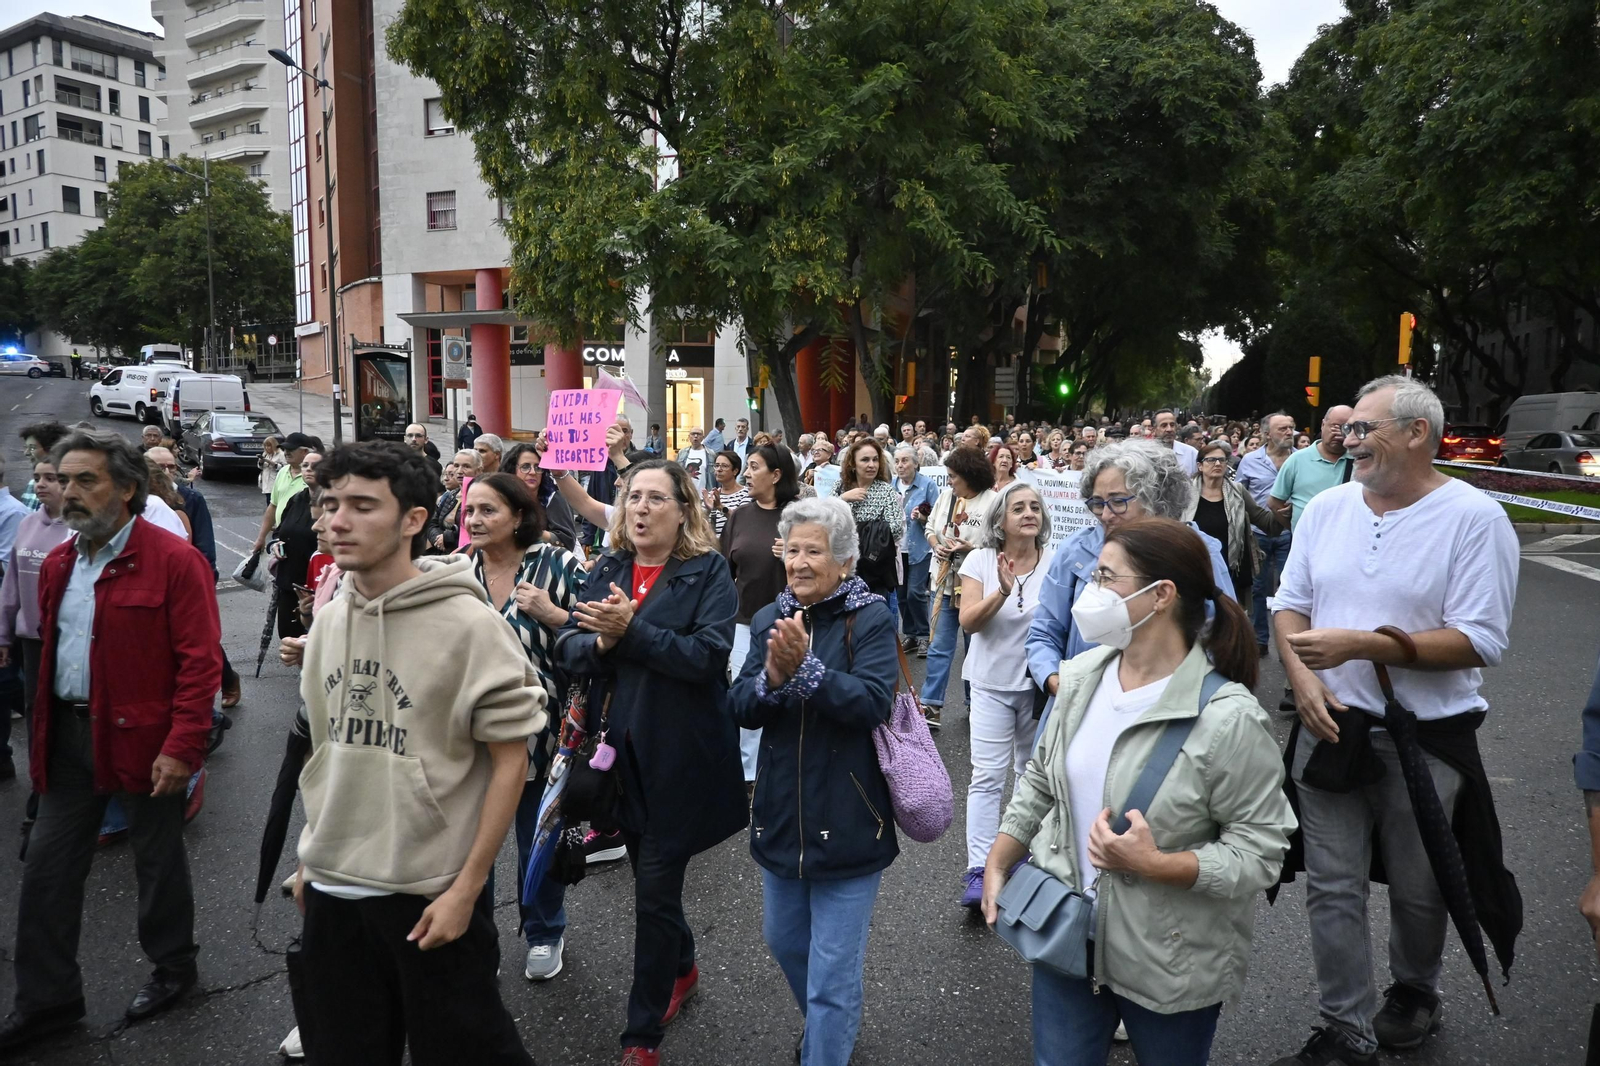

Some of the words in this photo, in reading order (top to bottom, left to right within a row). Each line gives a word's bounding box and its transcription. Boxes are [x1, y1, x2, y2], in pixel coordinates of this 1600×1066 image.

[563, 392, 588, 407] VIDA
[551, 412, 574, 426] VALE
[547, 430, 563, 443] QUE
[568, 428, 589, 443] TUS
[555, 447, 605, 464] RECORTES
[1044, 479, 1080, 489] MOVIMIEN
[1053, 490, 1069, 499] JUNTA
[1070, 491, 1077, 499] DE
[1062, 503, 1074, 513] MÁS
[1061, 516, 1084, 525] SERVICIO
[352, 658, 380, 678] HAT
